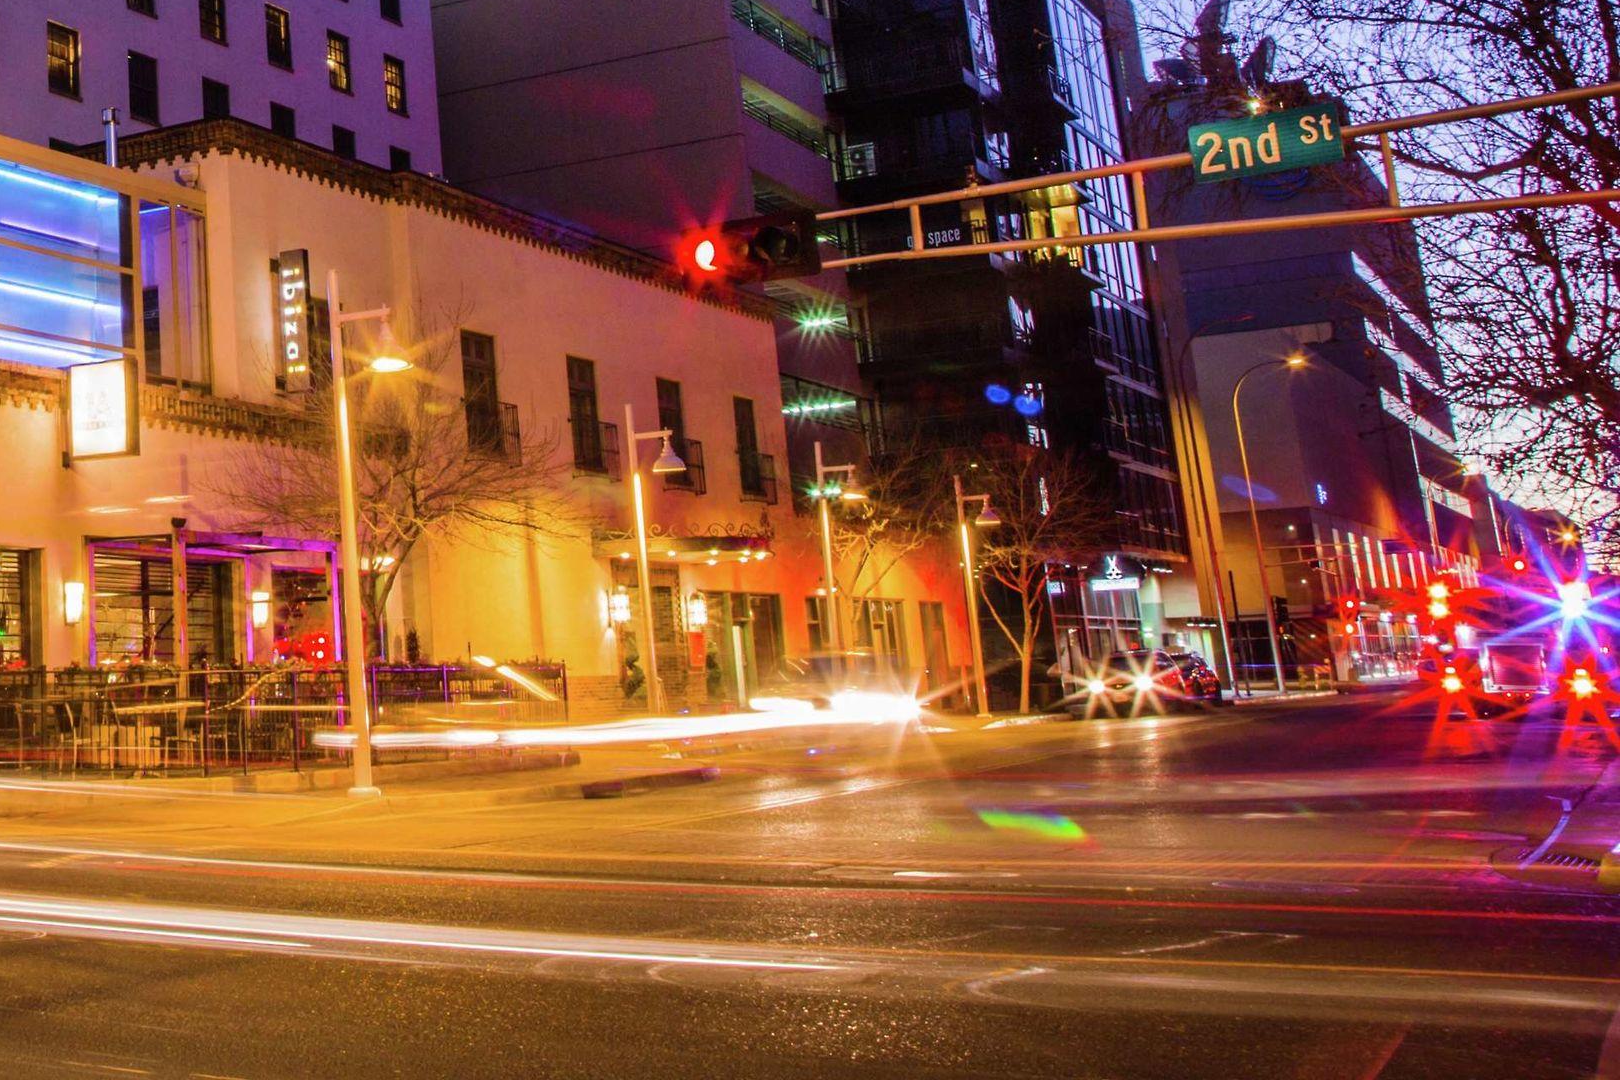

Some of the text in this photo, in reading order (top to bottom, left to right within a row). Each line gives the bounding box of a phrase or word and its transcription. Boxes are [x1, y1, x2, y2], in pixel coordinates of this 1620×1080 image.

[1196, 113, 1334, 174] 2nd St
[927, 228, 961, 247] space
